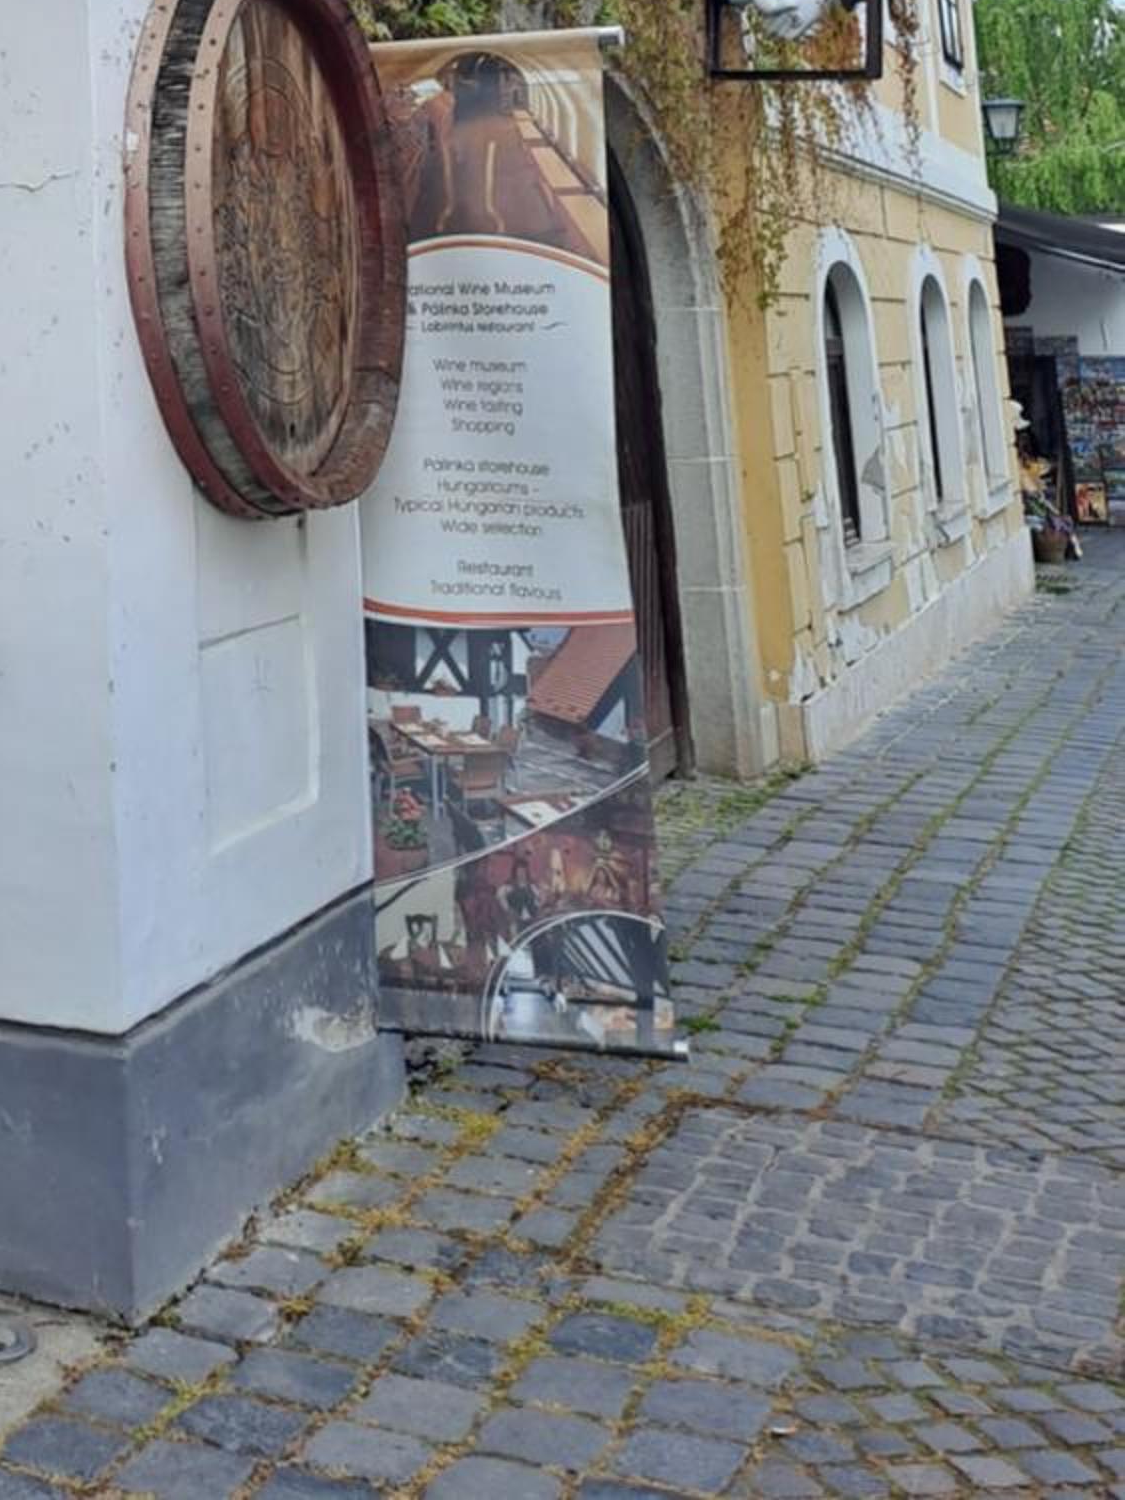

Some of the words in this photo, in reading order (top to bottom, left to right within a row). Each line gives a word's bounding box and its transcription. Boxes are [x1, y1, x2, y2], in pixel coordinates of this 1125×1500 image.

[408, 278, 455, 296] ational
[458, 282, 490, 296] Wine
[494, 281, 556, 296] Museum
[472, 302, 549, 316] Storehouse
[433, 359, 466, 372] Wine
[469, 360, 527, 372] museum
[441, 378, 473, 392] Wine
[476, 380, 523, 396] regions
[444, 399, 477, 412] Wine
[480, 399, 523, 416] tasting
[451, 417, 515, 437] Shopping
[478, 460, 550, 476] storehouse
[394, 496, 443, 514] Typical
[448, 498, 521, 516] Hungarian
[523, 501, 586, 518] products
[440, 519, 477, 533] Wide
[481, 521, 542, 537] selection
[457, 559, 534, 578] Restaurant
[430, 579, 505, 597] Traditional
[509, 582, 563, 602] flavours
